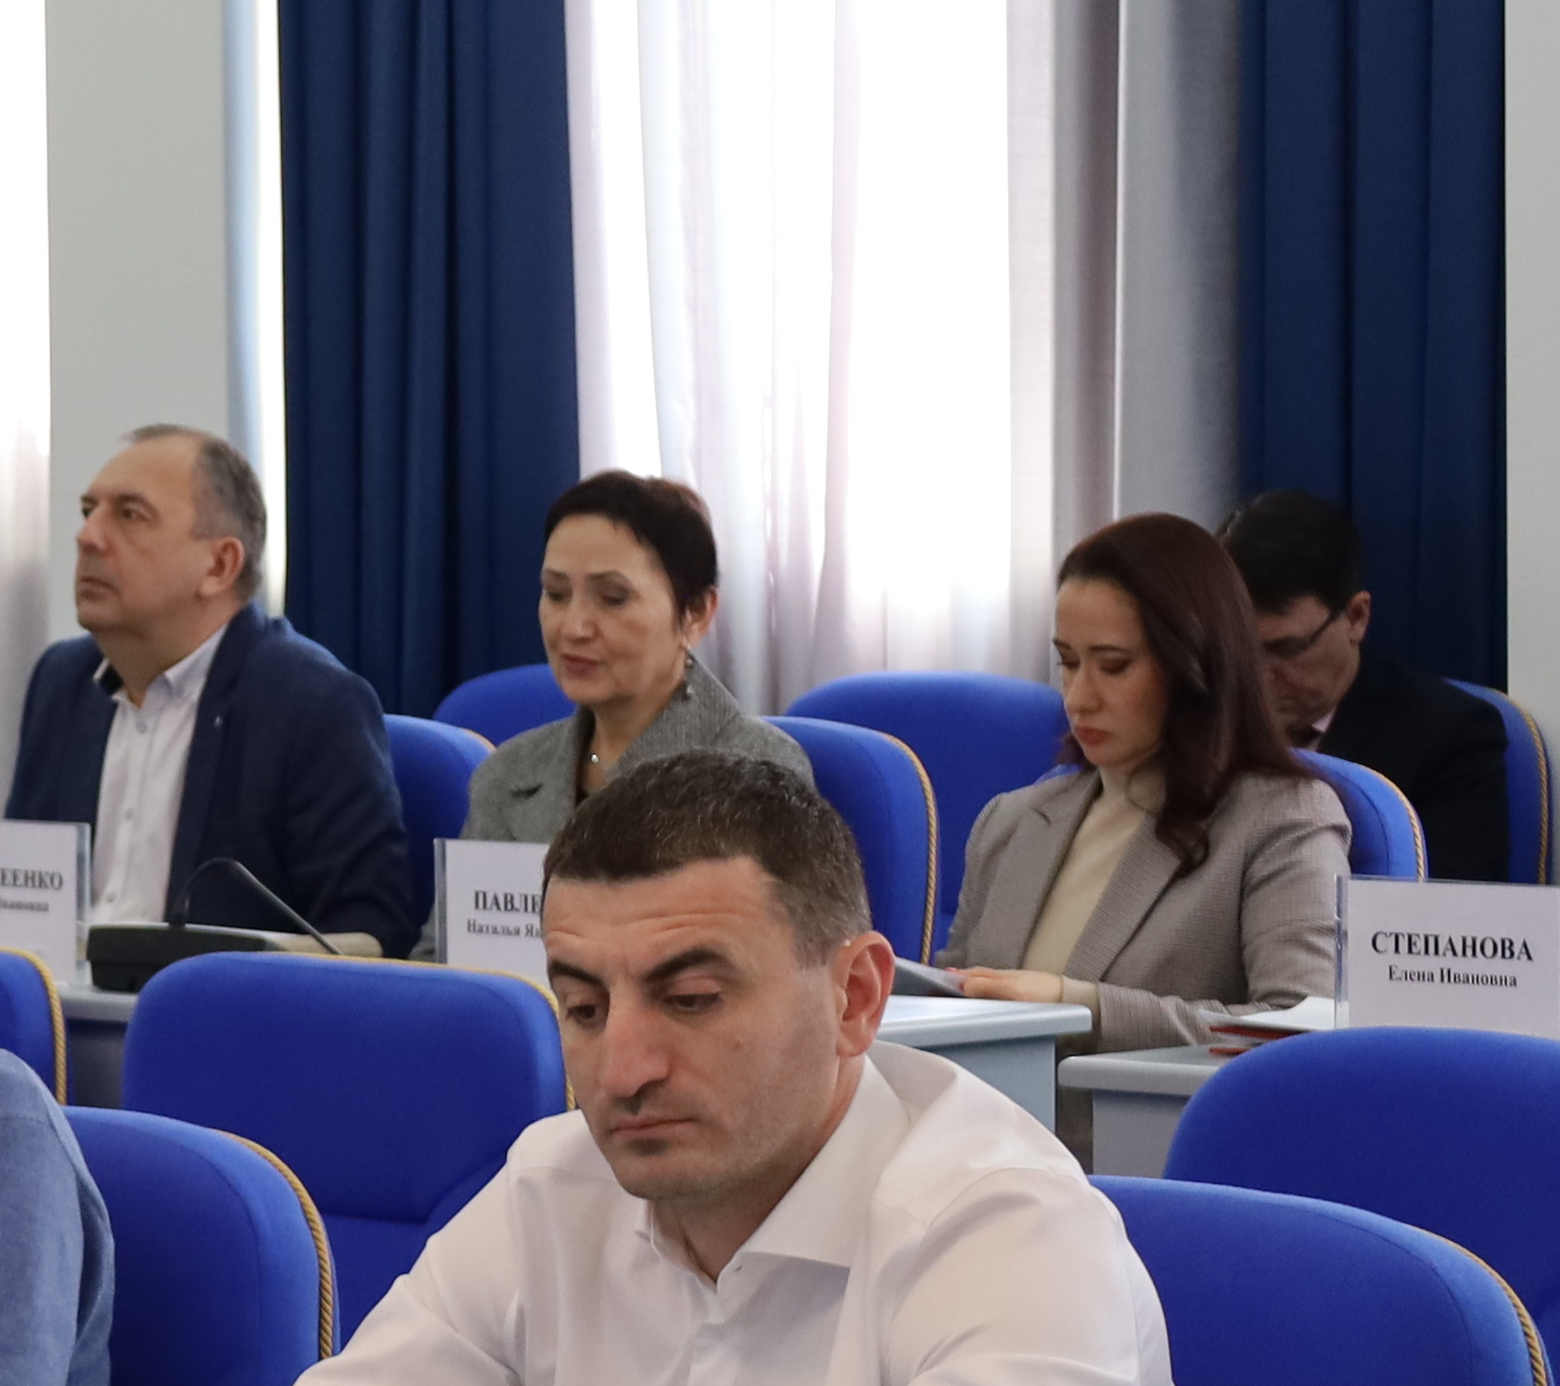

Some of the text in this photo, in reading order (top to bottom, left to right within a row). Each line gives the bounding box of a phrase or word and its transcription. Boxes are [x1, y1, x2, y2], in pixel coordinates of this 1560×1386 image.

[1371, 930, 1534, 962] СТЕПАНОВА
[1388, 964, 1518, 988] Елена Ивановна
